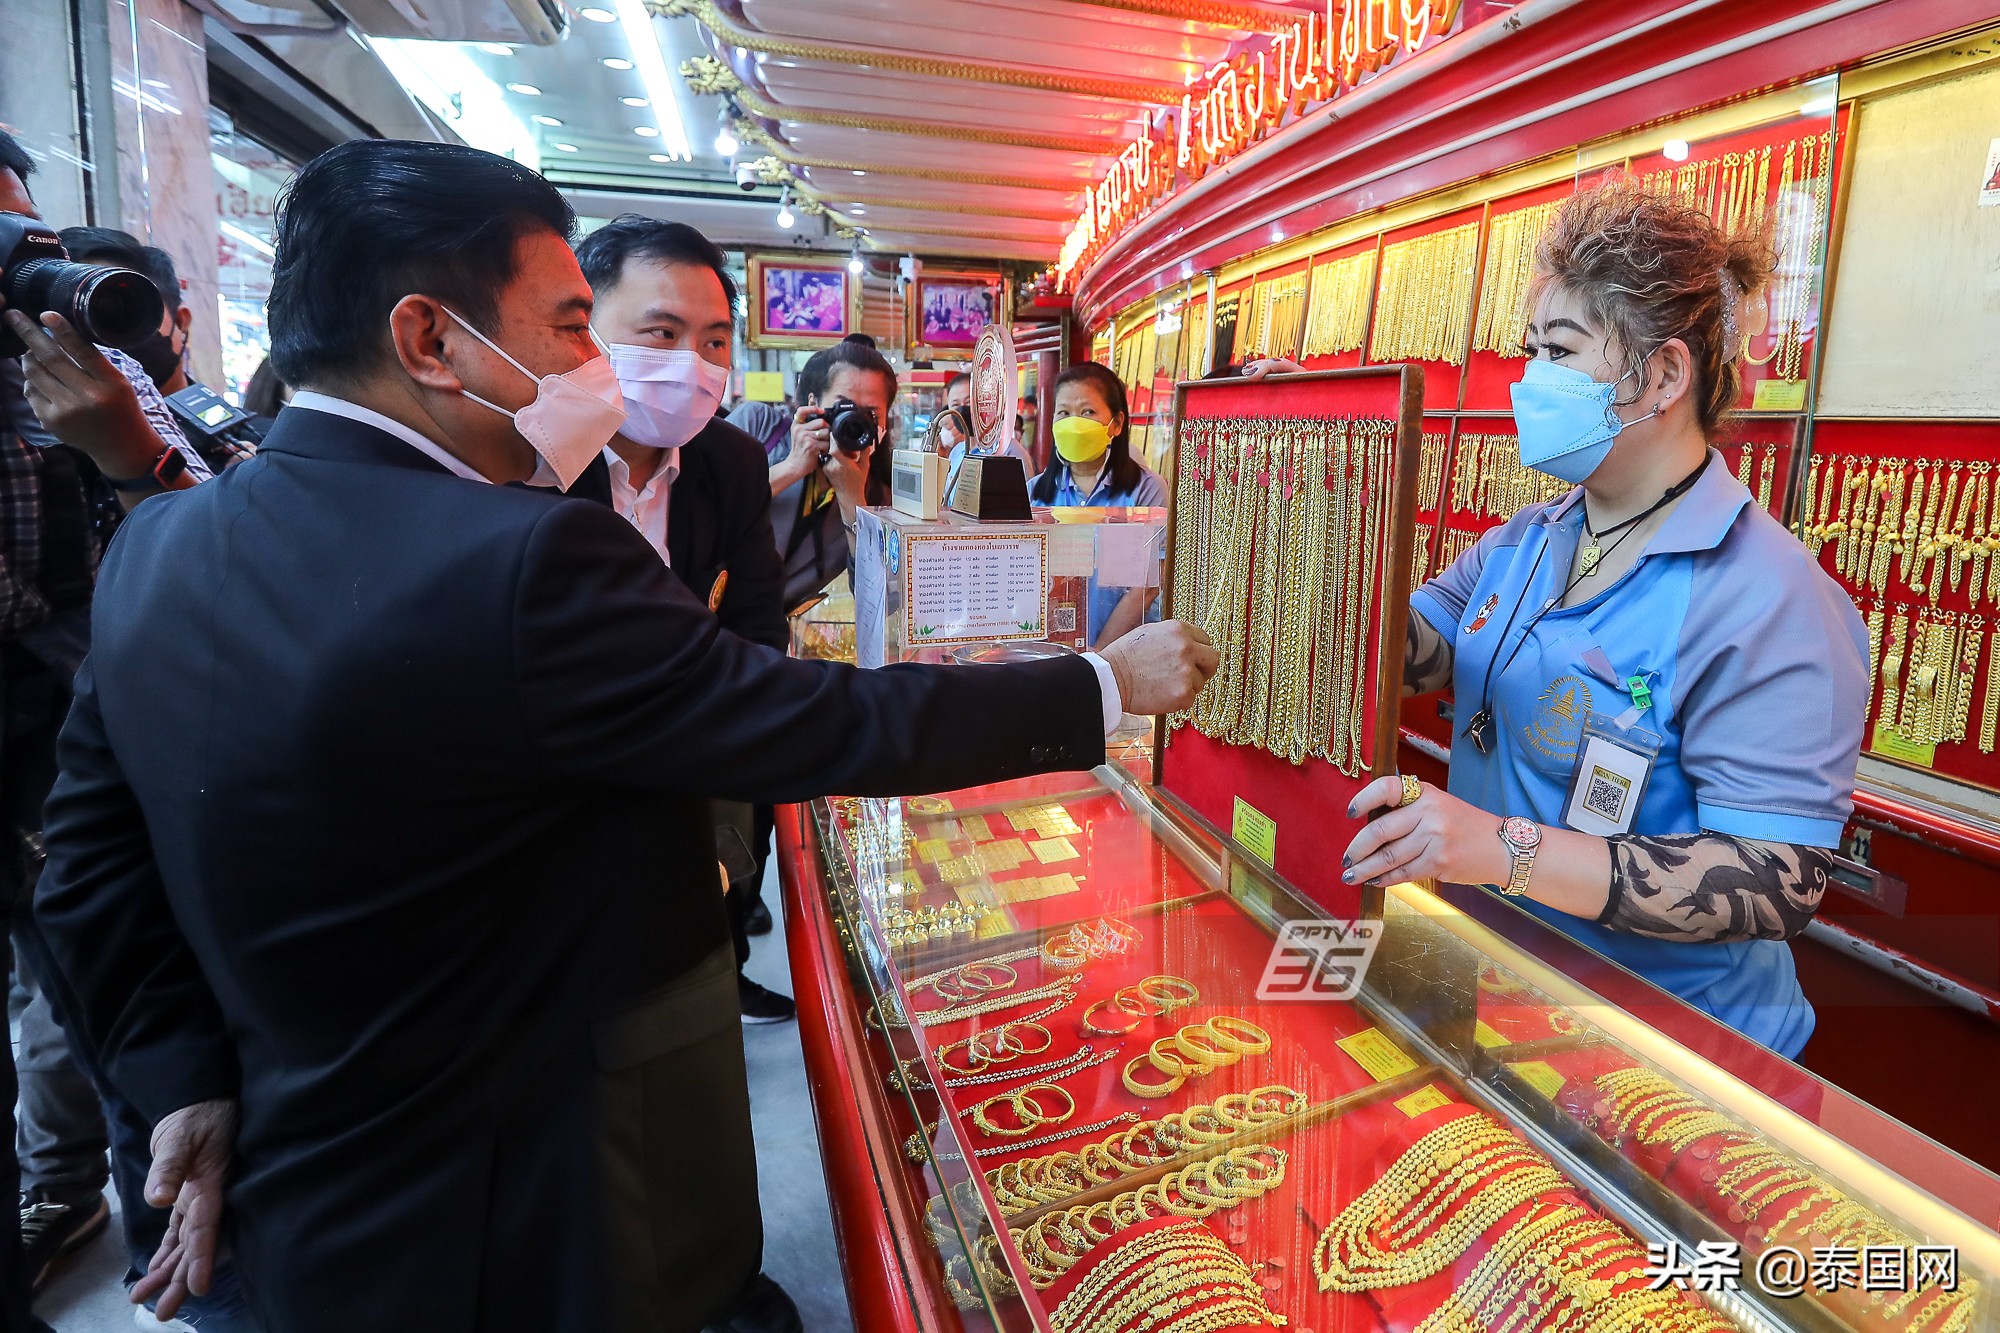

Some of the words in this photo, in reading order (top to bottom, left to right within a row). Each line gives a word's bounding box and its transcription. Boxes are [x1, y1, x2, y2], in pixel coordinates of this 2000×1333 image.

[27, 234, 59, 245] Canon
[1595, 768, 1610, 780] SCAN
[1611, 776, 1628, 788] HERE
